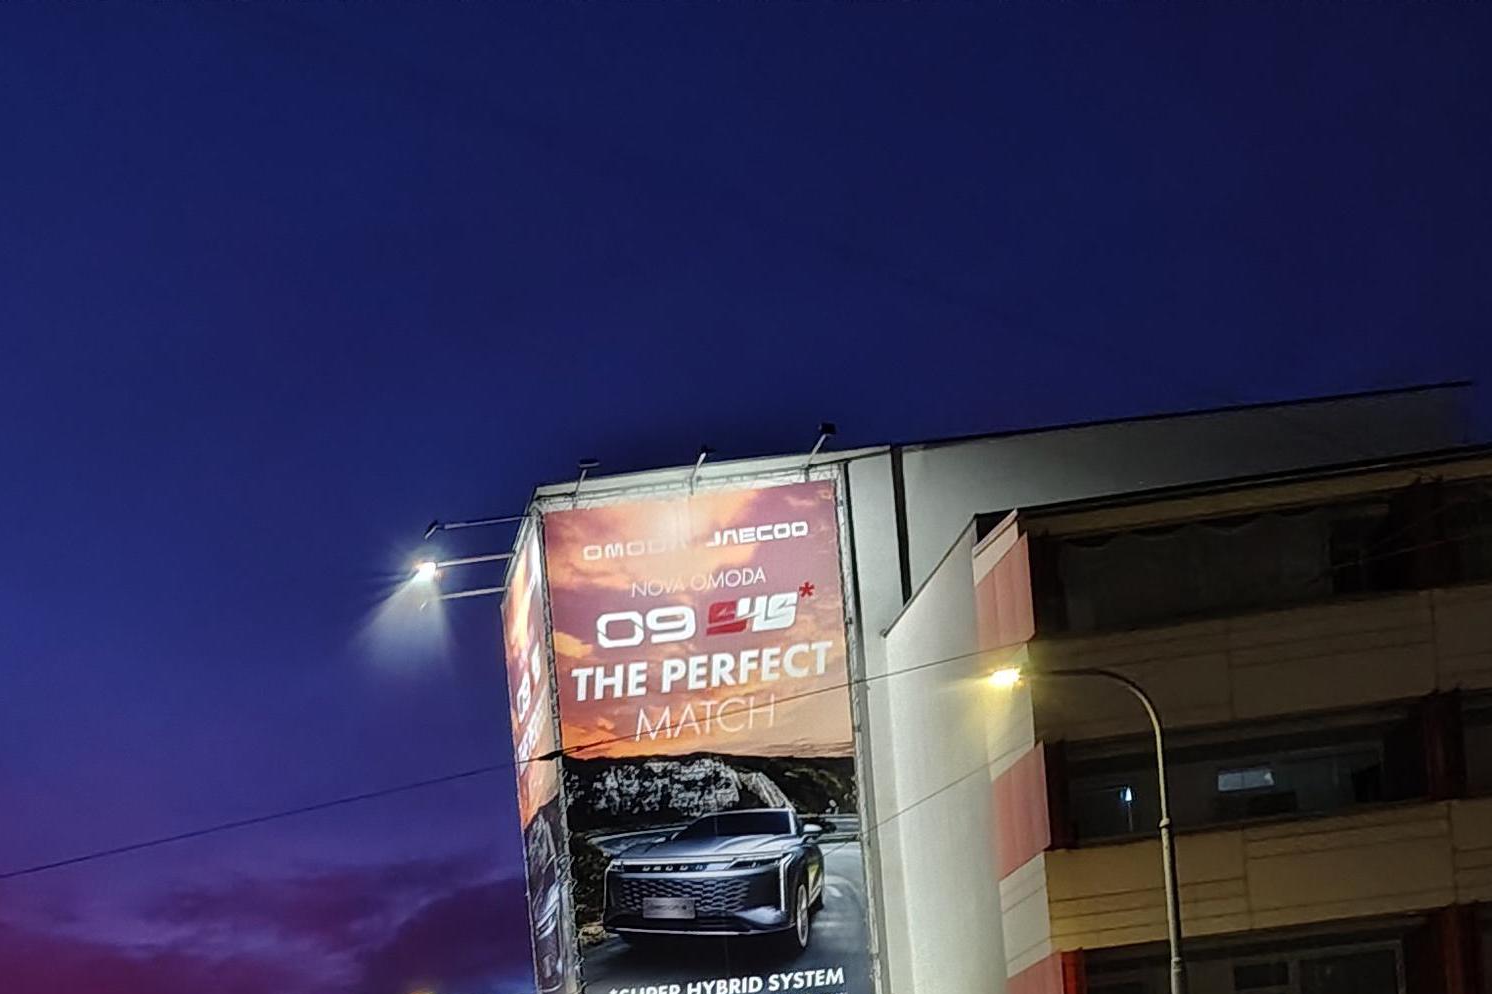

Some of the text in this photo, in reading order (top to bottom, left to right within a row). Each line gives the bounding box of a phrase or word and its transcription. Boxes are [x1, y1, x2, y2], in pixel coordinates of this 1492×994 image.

[706, 520, 808, 547] JAECOO
[631, 566, 767, 598] NOVA OMODA
[596, 605, 696, 648] 09
[571, 640, 833, 702] THE PERFECT
[635, 692, 775, 742] MATCH
[768, 967, 845, 991] SYSTEM
